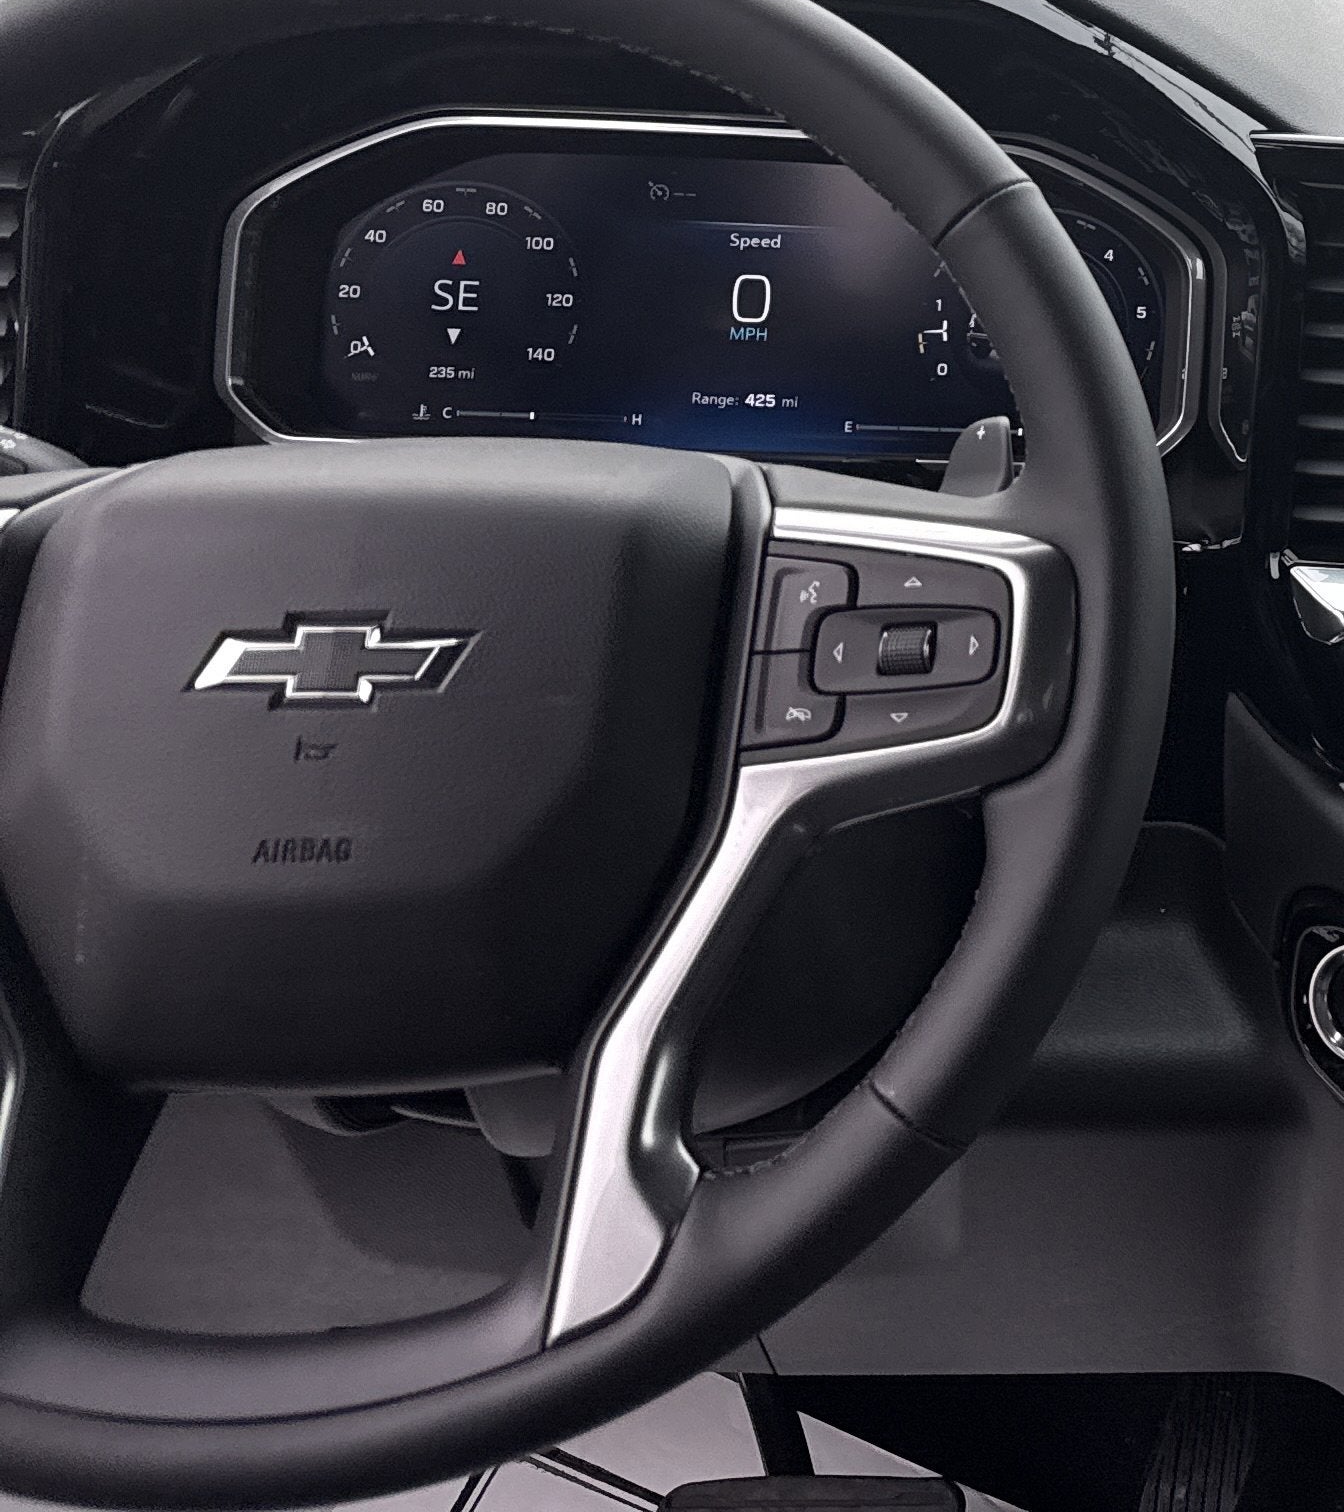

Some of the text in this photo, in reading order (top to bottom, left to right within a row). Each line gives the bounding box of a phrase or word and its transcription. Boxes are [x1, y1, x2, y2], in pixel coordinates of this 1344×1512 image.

[422, 199, 444, 213] 60
[486, 202, 507, 216] 80
[364, 230, 386, 243] 40
[730, 234, 781, 251] Speed
[526, 237, 554, 250] 100
[1104, 250, 1114, 261] 4
[339, 285, 361, 299] 20
[431, 279, 480, 311] SE
[732, 274, 770, 323] 0
[546, 293, 573, 308] 120
[936, 299, 942, 311] 1
[1136, 306, 1146, 319] 5
[730, 327, 768, 342] MPH
[527, 348, 555, 361] 140
[429, 367, 475, 380] 235 mi
[937, 363, 948, 376] 0
[691, 392, 799, 408] Range: 425 mi
[443, 406, 452, 419] C
[631, 414, 642, 426] H
[845, 421, 853, 433] E
[251, 838, 353, 866] AIRBAG
